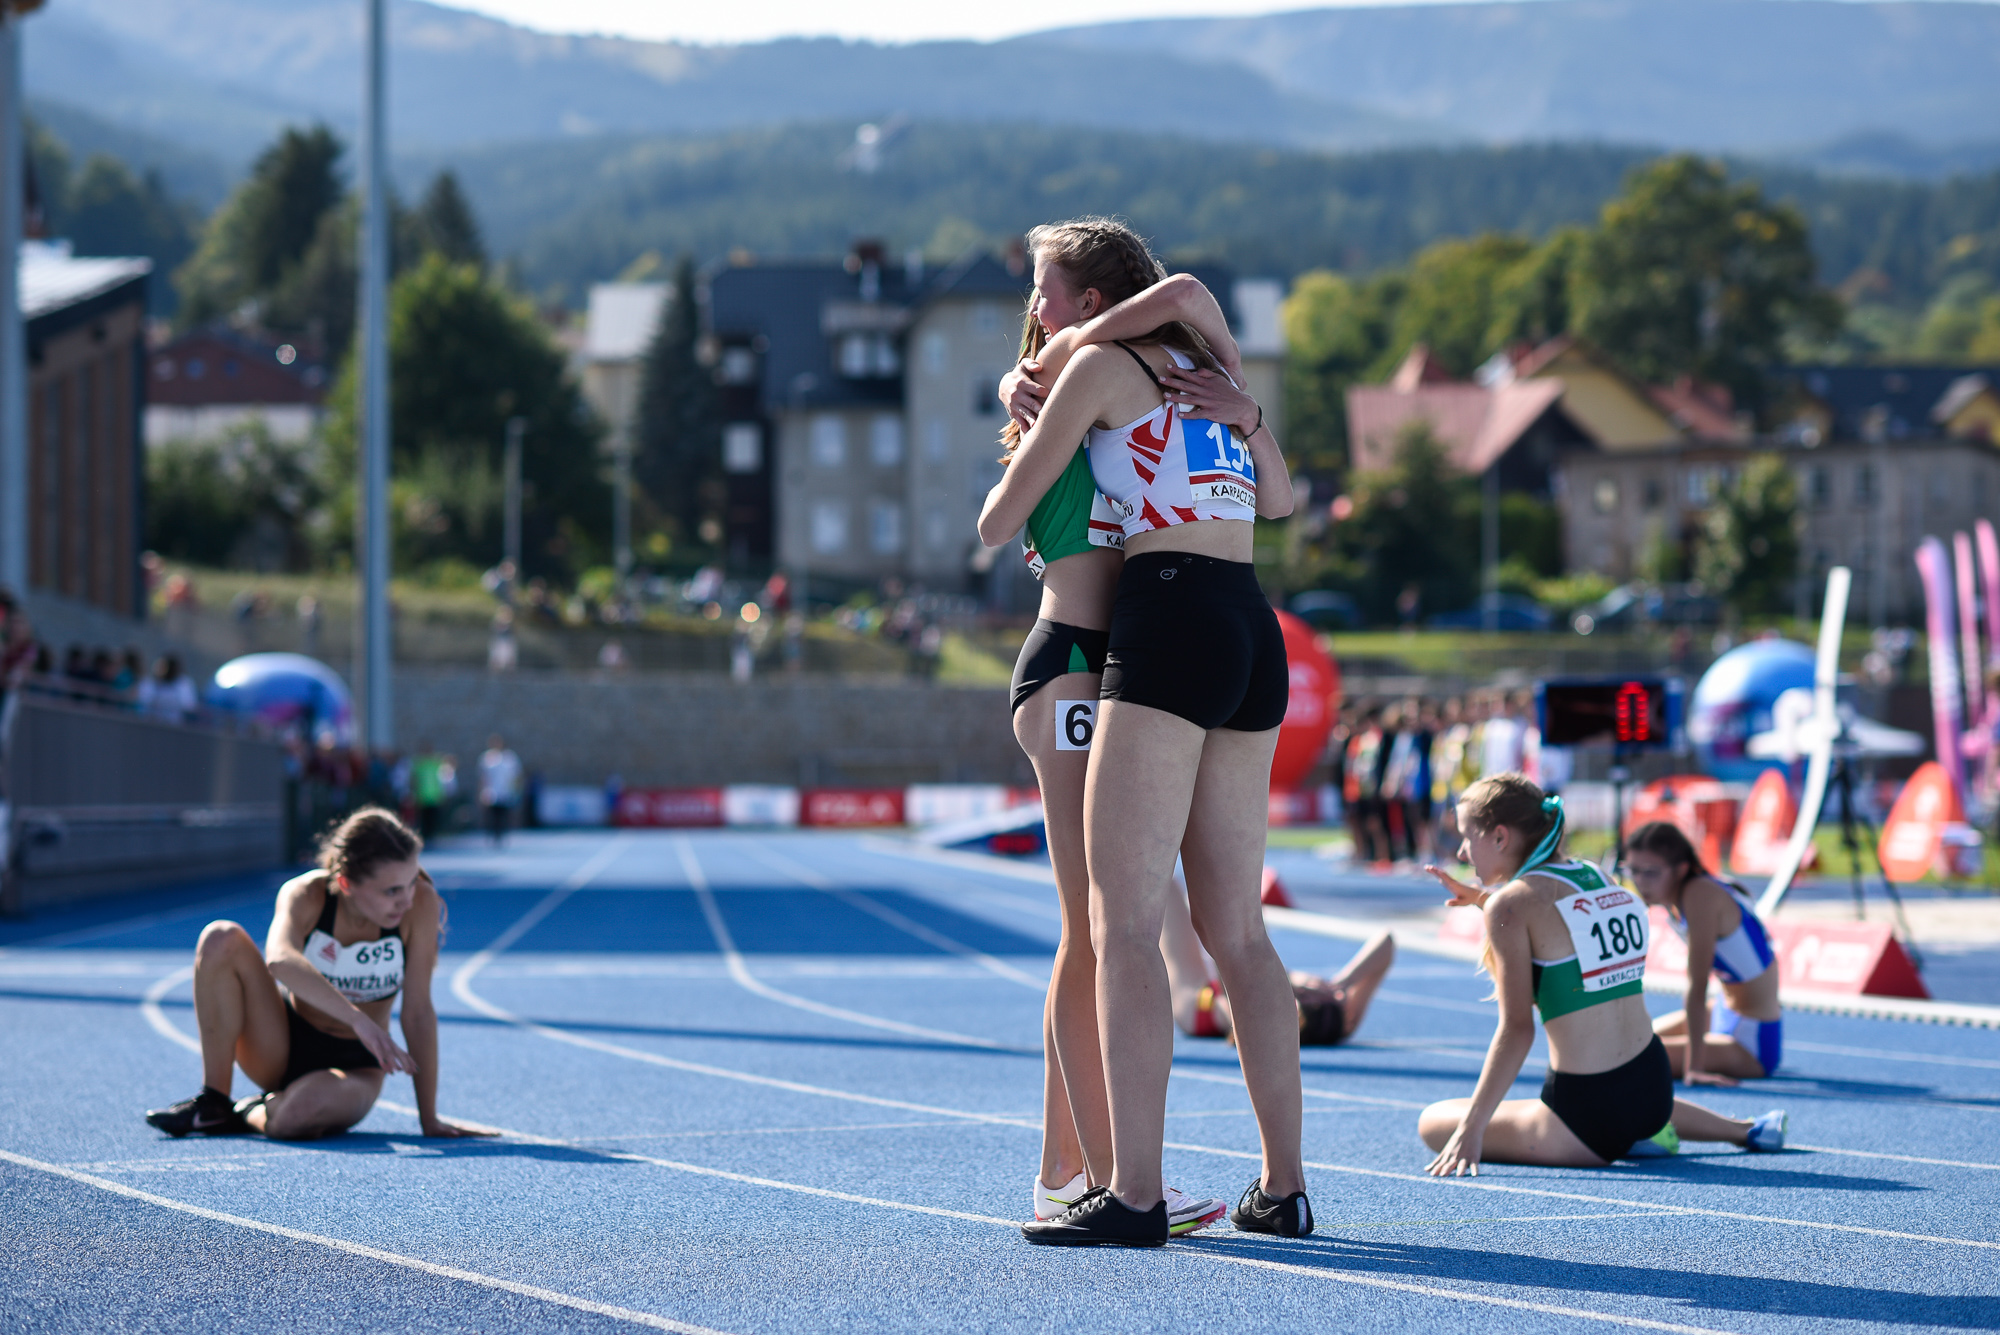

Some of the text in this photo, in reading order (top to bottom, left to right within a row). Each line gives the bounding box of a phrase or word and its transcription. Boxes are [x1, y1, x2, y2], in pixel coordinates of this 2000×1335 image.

[1210, 485, 1247, 503] KARPACZ
[1065, 703, 1093, 747] 6
[356, 942, 395, 964] 695
[1591, 913, 1644, 961] 180
